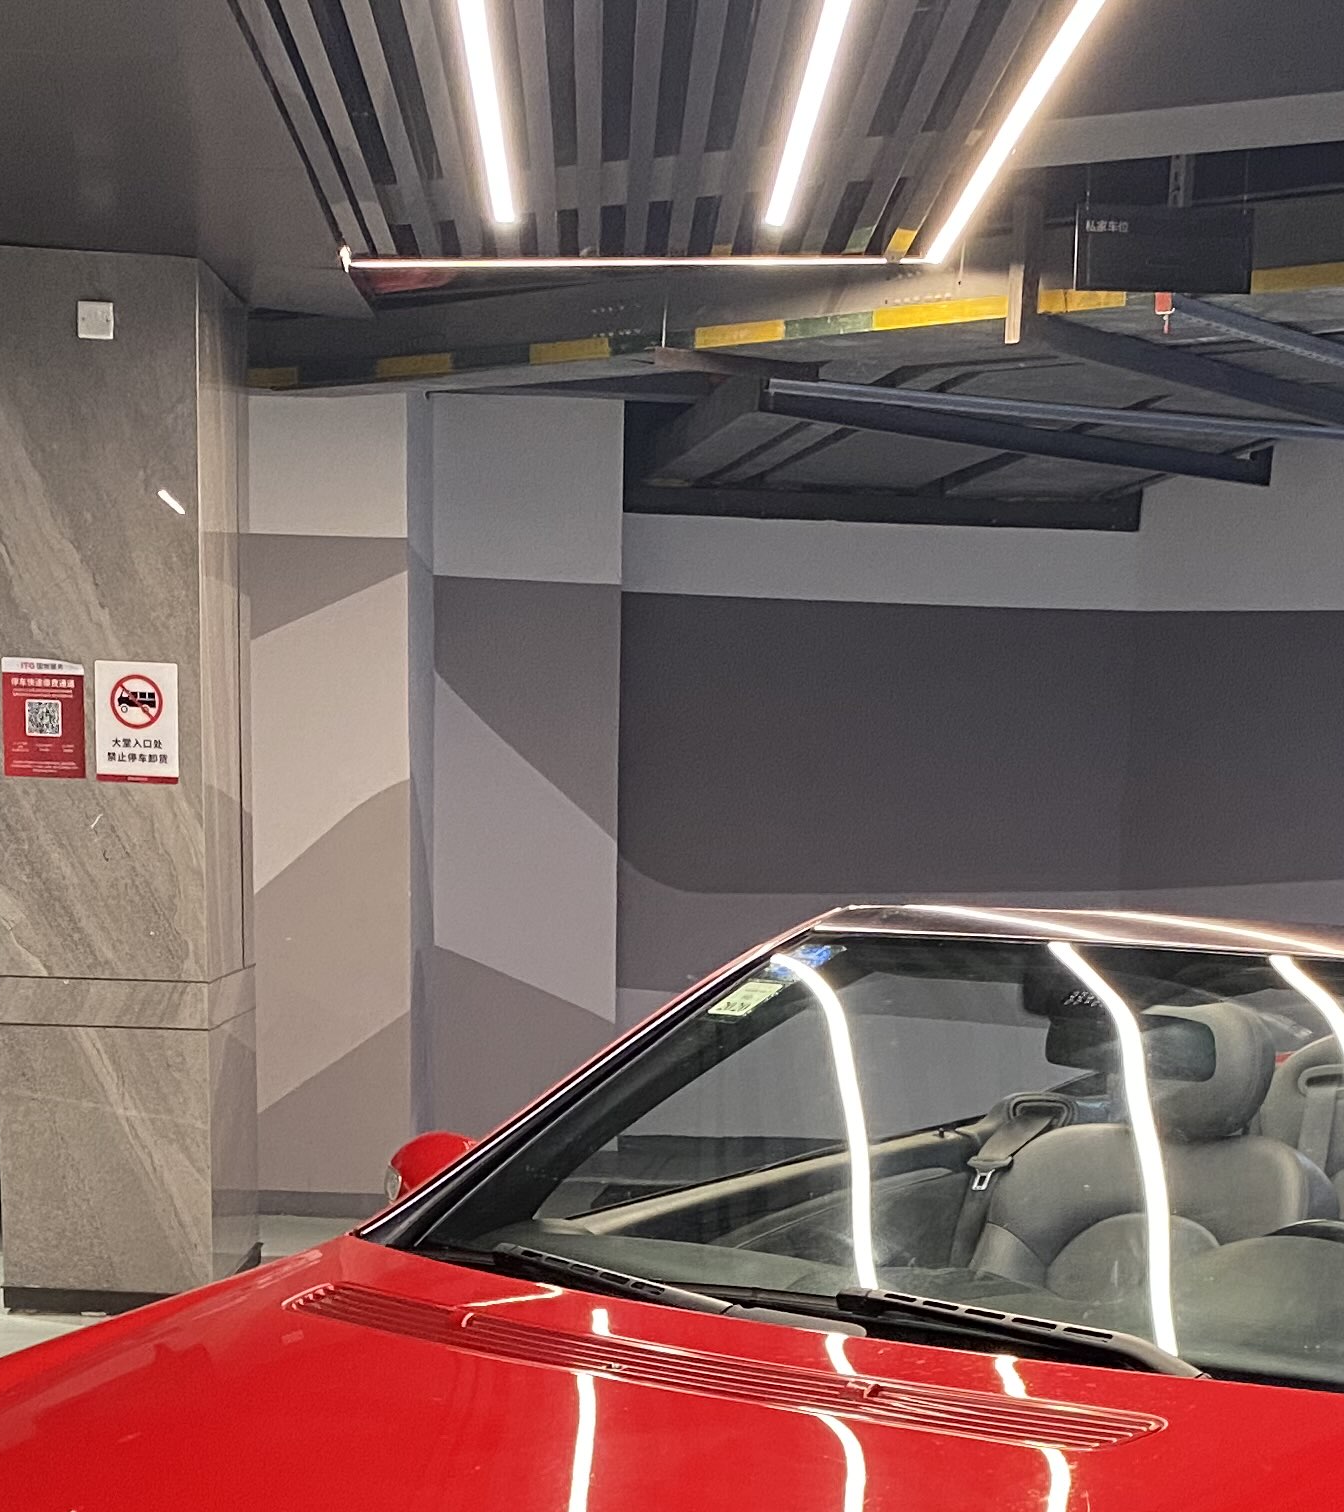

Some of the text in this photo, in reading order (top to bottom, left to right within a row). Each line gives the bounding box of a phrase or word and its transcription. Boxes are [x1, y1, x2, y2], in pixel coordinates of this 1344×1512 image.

[112, 738, 163, 750] 大堂入口处
[107, 751, 168, 764] 禁止停车卸货
